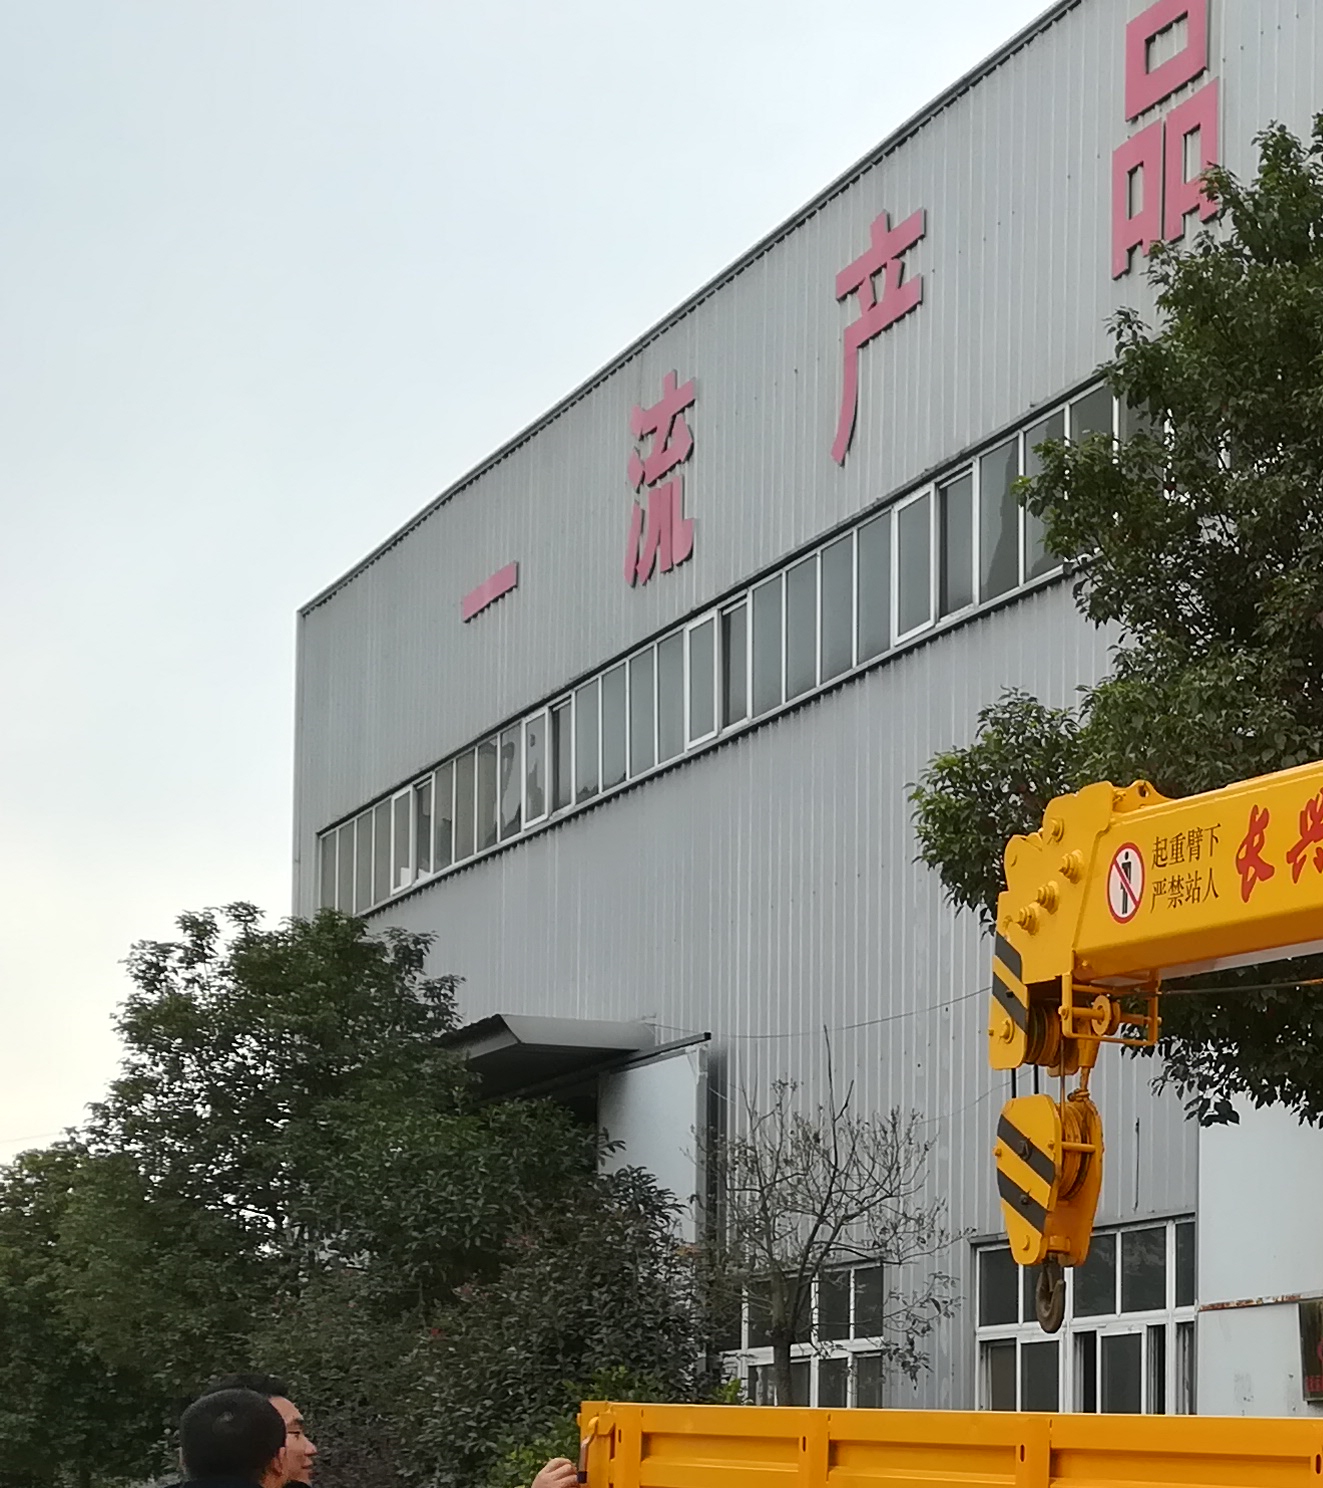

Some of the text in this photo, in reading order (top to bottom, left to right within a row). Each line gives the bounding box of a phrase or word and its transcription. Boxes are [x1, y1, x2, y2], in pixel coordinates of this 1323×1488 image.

[461, 0, 1219, 624] 一流产品
[1151, 823, 1222, 870] 起重臂下
[1150, 868, 1220, 914] 严禁站人
